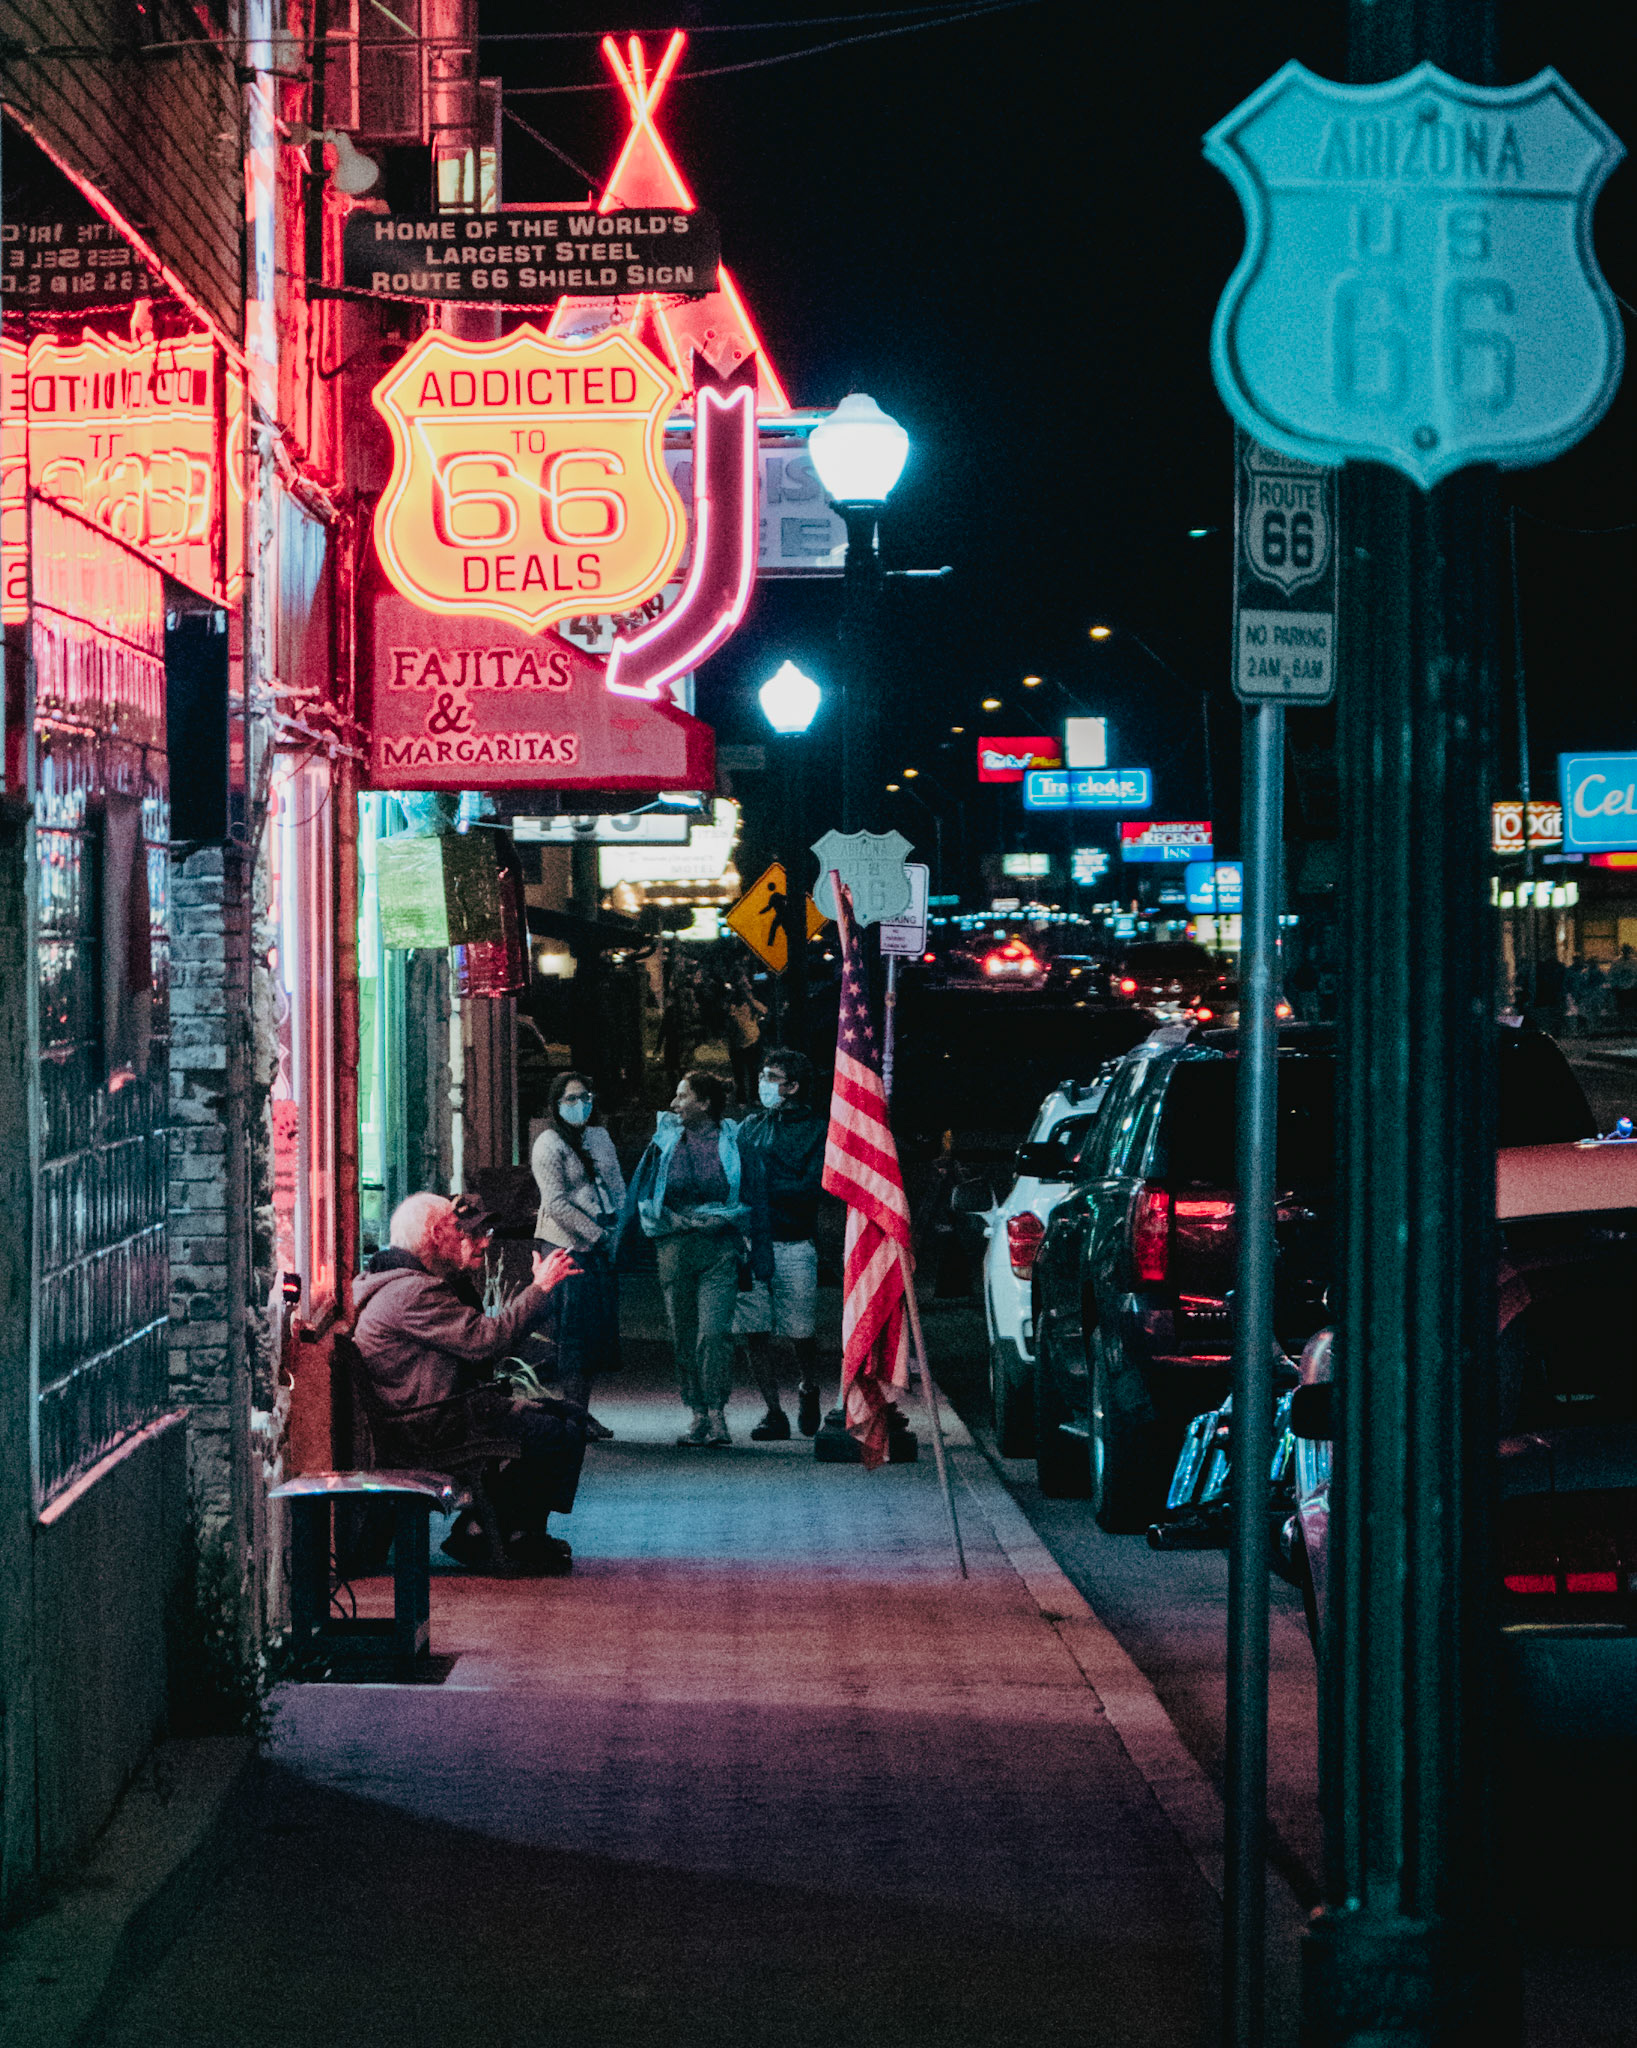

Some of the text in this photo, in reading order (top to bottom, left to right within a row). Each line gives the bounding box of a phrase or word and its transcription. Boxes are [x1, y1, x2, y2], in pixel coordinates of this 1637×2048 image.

[1317, 117, 1527, 181] ARIZONA
[374, 215, 690, 242] HOME OF THE WORLD'S
[425, 241, 640, 266] LARGEST STEEL
[371, 264, 695, 292] ROUTE 66 SHIELD SIGN
[417, 366, 638, 409] ADDICTED
[509, 429, 547, 454] TO
[431, 446, 628, 550] 66
[1258, 481, 1316, 509] ROUTE
[1262, 510, 1315, 568] 66
[462, 553, 602, 593] DEALS
[1246, 624, 1327, 648] NO PARKING
[393, 650, 569, 688] FAJITAS
[1247, 656, 1281, 677] 2AM
[428, 692, 471, 735] &
[384, 738, 574, 766] MARGARITAS
[1142, 831, 1212, 845] REGENCY
[1163, 845, 1191, 859] INN
